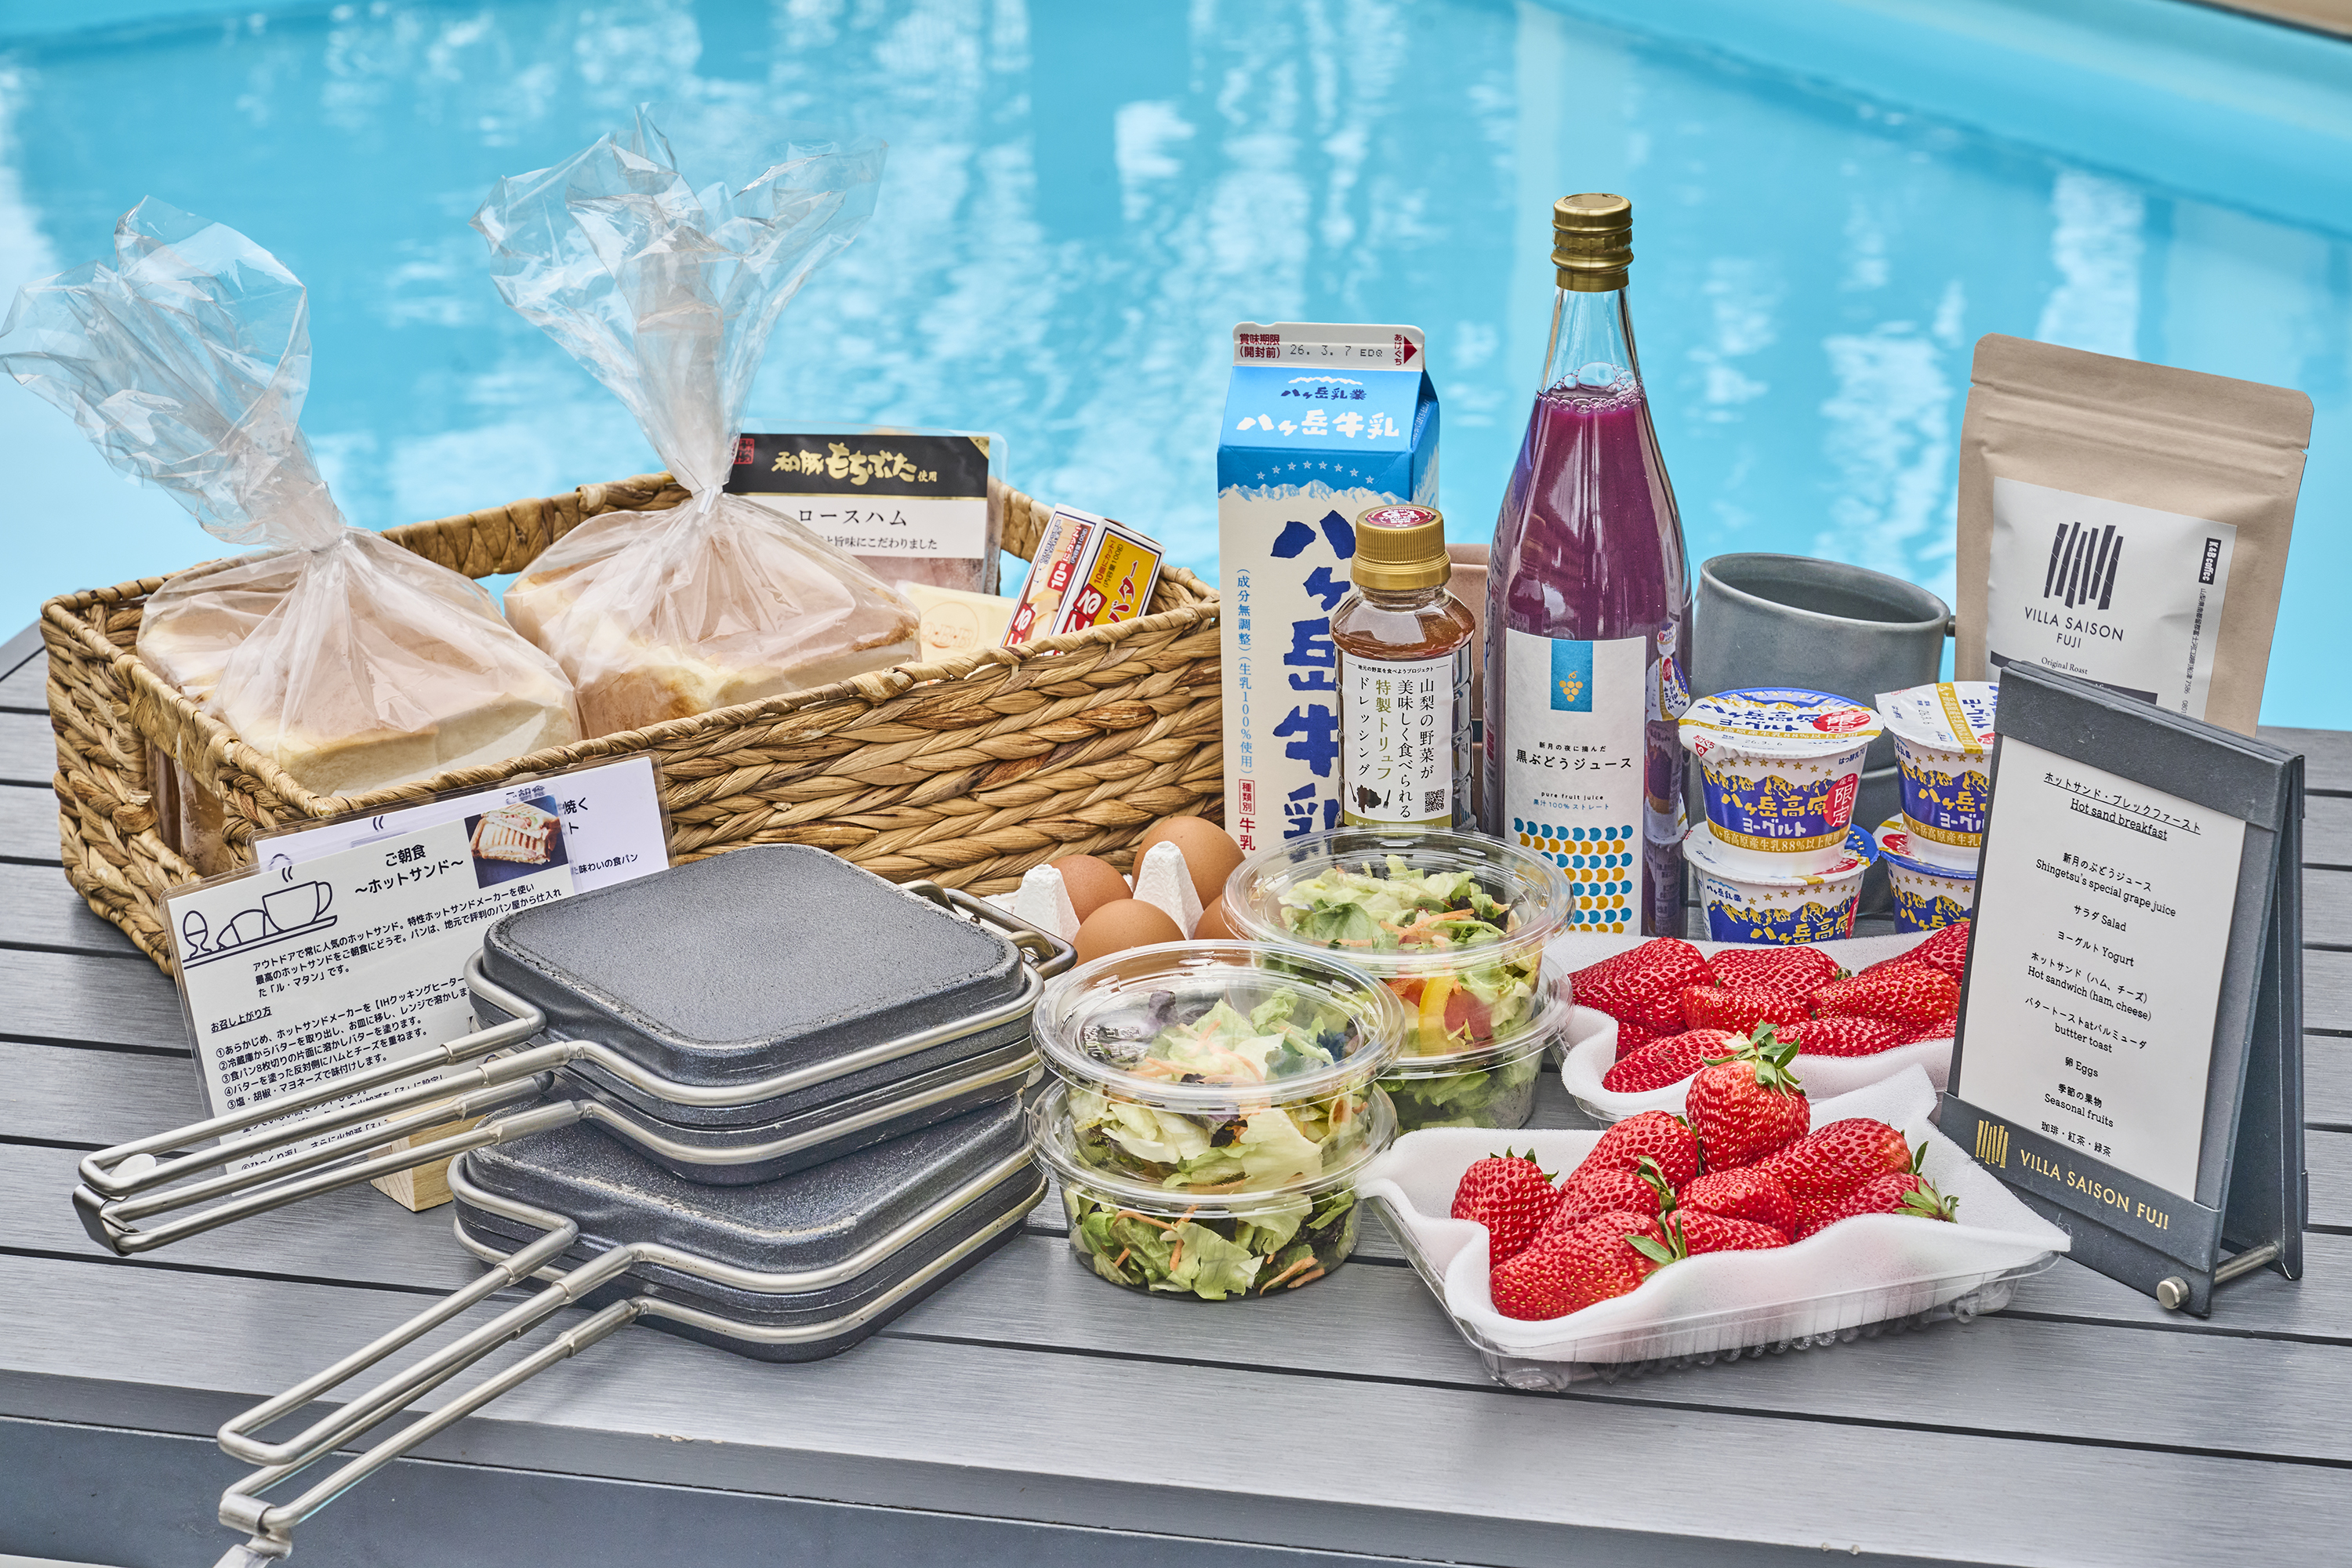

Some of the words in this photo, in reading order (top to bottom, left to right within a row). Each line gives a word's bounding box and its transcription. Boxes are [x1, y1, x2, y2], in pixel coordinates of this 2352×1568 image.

[1240, 334, 1280, 346] 賞味期限
[1345, 346, 1352, 357] 7
[1394, 334, 1403, 366] あけぐち
[799, 510, 907, 527] ロースハム
[2024, 606, 2060, 627] VILLA
[2065, 617, 2125, 642] SAISON
[2056, 633, 2082, 648] FUJI
[2041, 656, 2069, 670] Original
[2069, 663, 2089, 675] Roast
[1358, 677, 1370, 776] ドレッシング
[1375, 679, 1394, 780] 特製トリュフ
[1420, 678, 1435, 780] 山梨の野菜が
[1398, 679, 1414, 818] 美味しく食べられる
[1515, 749, 1632, 771] 黒ぶどうジュース
[1242, 782, 1252, 812] 種類別
[2044, 771, 2201, 834] ホットサンド・ブレックファースト
[1239, 817, 1256, 851] 牛乳
[1742, 817, 1807, 837] ヨーグルト
[2070, 798, 2089, 816] Hot
[2090, 805, 2117, 824] sand
[2118, 812, 2168, 840] breakfast
[384, 844, 426, 868] ご朝食
[2063, 852, 2152, 892] 新月のぶどうジュース
[2036, 858, 2088, 886] Shingetsu's
[2089, 878, 2122, 901] special
[2123, 889, 2151, 909] grape
[2151, 898, 2176, 917] juice
[2074, 904, 2100, 921] サラダ
[2101, 914, 2127, 932] Salad
[2057, 931, 2100, 953] ヨーグルト
[2102, 945, 2135, 967] Yogurt
[2027, 965, 2045, 982] Hot
[2045, 971, 2088, 998] sandwich
[2089, 987, 2114, 1010] (ham,
[2115, 1000, 2152, 1022] cheese)
[210, 1005, 273, 1034] お召し上がり方
[2054, 1022, 2088, 1044] buttter
[2089, 1034, 2113, 1054] toast
[2064, 1056, 2074, 1068] 卵
[2075, 1060, 2099, 1078] Eggs
[2044, 1093, 2085, 1118] Seasonal
[2086, 1109, 2114, 1128] fruits
[2057, 1083, 2103, 1109] 季節の果物
[2041, 1120, 2112, 1158] 珈琲・紅茶・緑茶
[2020, 1149, 2061, 1181] VILLA
[2066, 1171, 2130, 1213] SAISON
[2136, 1202, 2169, 1230] FUJI
